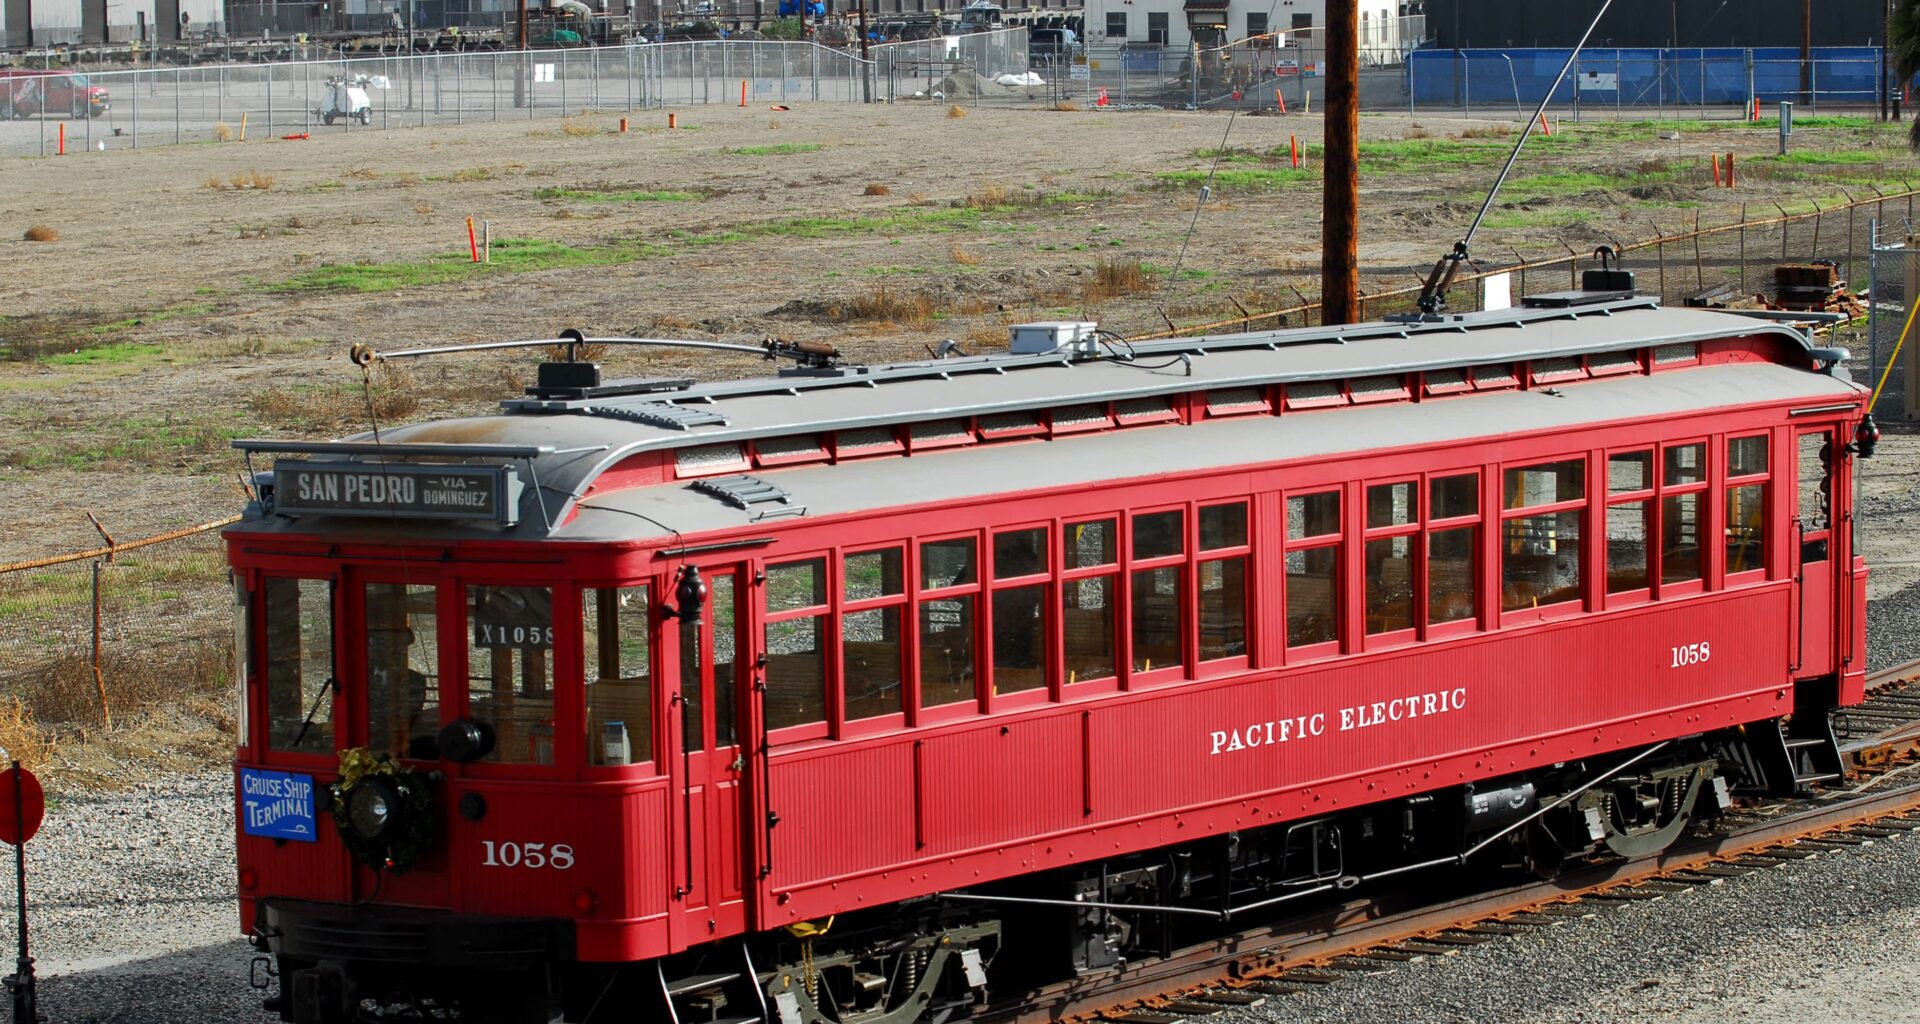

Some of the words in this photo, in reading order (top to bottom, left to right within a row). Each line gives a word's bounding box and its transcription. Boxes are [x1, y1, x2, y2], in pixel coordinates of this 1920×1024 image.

[298, 473, 338, 501] SAN
[344, 475, 416, 504] PEDRO
[423, 490, 488, 507] DOMINGUEZ
[1671, 641, 1710, 668] 1058
[1210, 713, 1325, 755] PACIFIC
[1339, 687, 1466, 731] ELECTRIC
[244, 774, 282, 797] CRUISE
[283, 778, 311, 800] SHIP
[245, 799, 312, 828] TERMINAL
[481, 840, 574, 869] 1058
